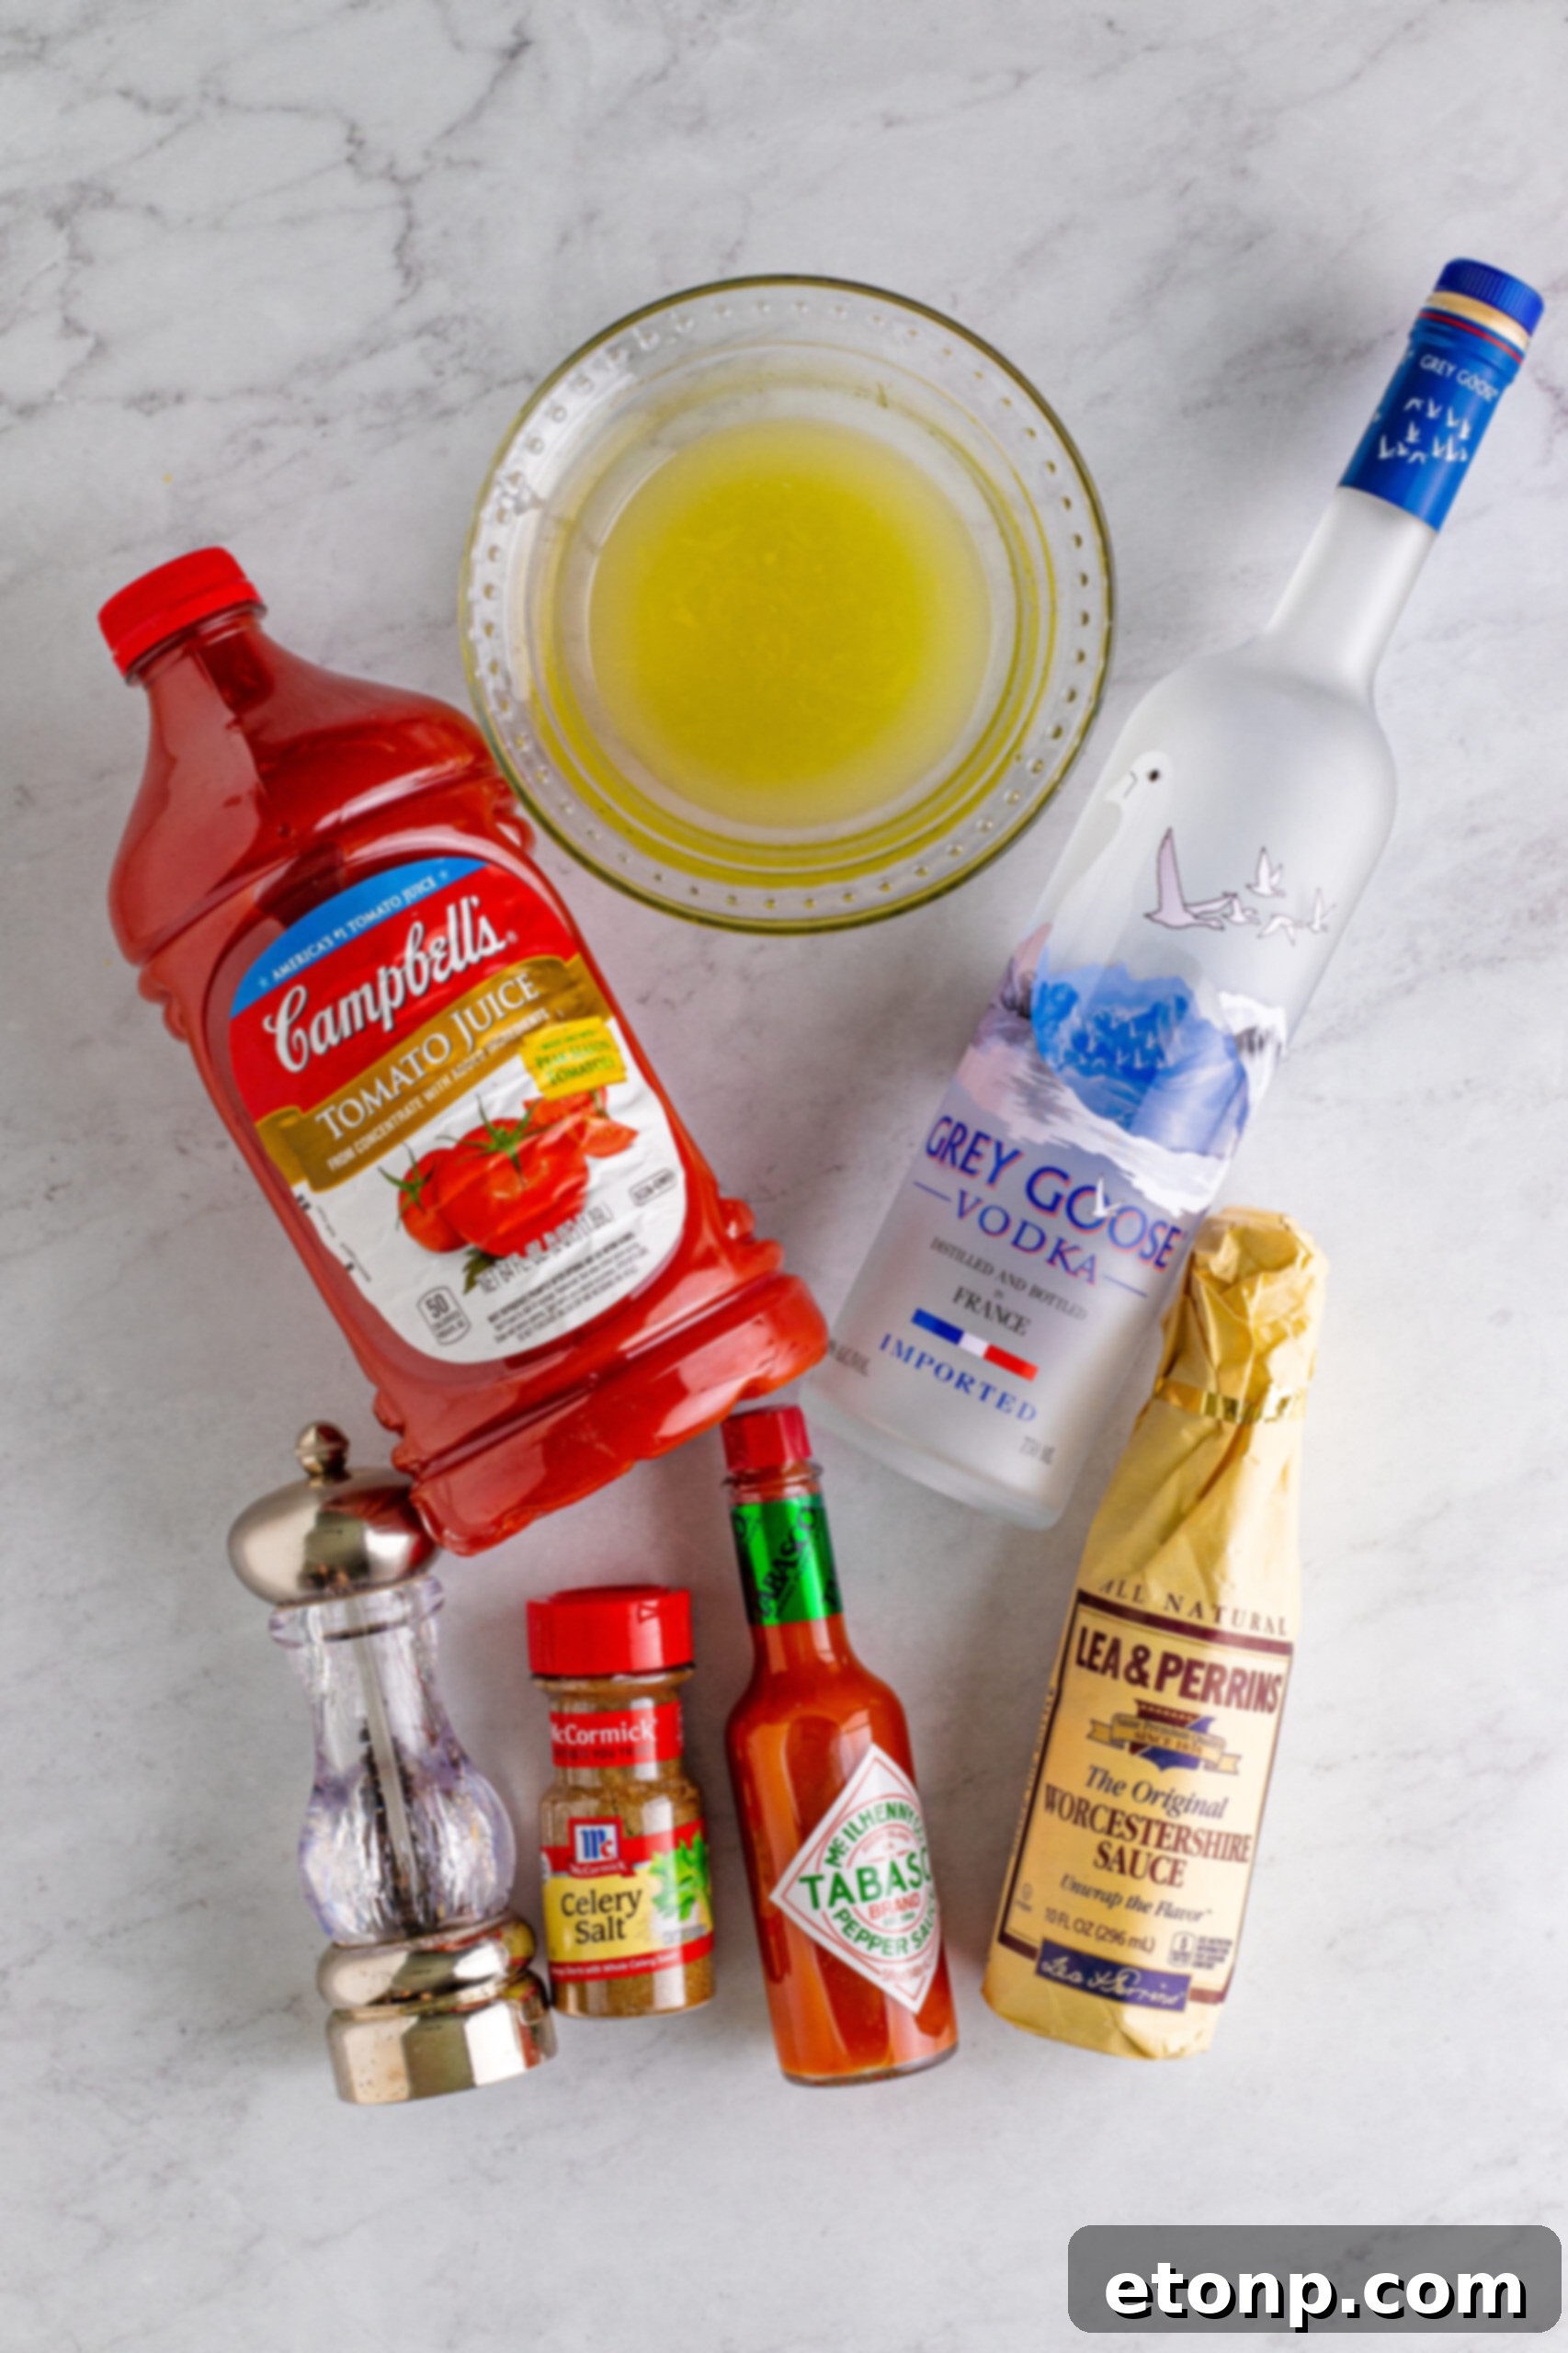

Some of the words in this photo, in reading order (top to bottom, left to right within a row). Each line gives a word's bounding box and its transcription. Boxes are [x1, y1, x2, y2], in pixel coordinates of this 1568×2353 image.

[271, 933, 334, 981] AMERICA'S
[347, 896, 402, 935] TOMATO
[402, 874, 437, 904] JUICE
[262, 894, 506, 1073] Campbell's
[315, 1033, 450, 1141] TOMATO
[450, 972, 540, 1053] JUICE
[327, 1148, 355, 1173] FROM
[355, 1100, 425, 1155] CONCENTRATE
[423, 1075, 452, 1104] WITH
[926, 1115, 1025, 1190] GREY
[1025, 1165, 1182, 1272] GOOSE
[956, 1188, 1097, 1285] VODKA
[929, 1235, 994, 1276] DISTILLED
[995, 1269, 1027, 1291] AND
[1028, 1283, 1088, 1321] BOTTLED
[426, 1293, 449, 1318] 50
[951, 1285, 1031, 1337] FRANCE
[878, 1332, 1039, 1422] IMPORTED
[1163, 1592, 1288, 1637] NATURAL
[1085, 1765, 1128, 1797] The
[1131, 1779, 1230, 1821] Original
[1044, 1782, 1253, 1864] WORCESTERSHIRE
[1092, 1840, 1188, 1889] SAUCE
[560, 1888, 642, 1919] Celery
[868, 1892, 921, 1920] BRAND
[1060, 1873, 1123, 1911] Unwrap
[1124, 1894, 1153, 1914] the
[575, 1915, 627, 1945] Salt
[833, 1906, 909, 1957] PEPPER
[1044, 1906, 1057, 1925] 10
[1056, 1912, 1070, 1930] FL
[1073, 1916, 1095, 1938] OZ
[1095, 1923, 1127, 1948] (296
[1128, 1934, 1156, 1955] mL)
